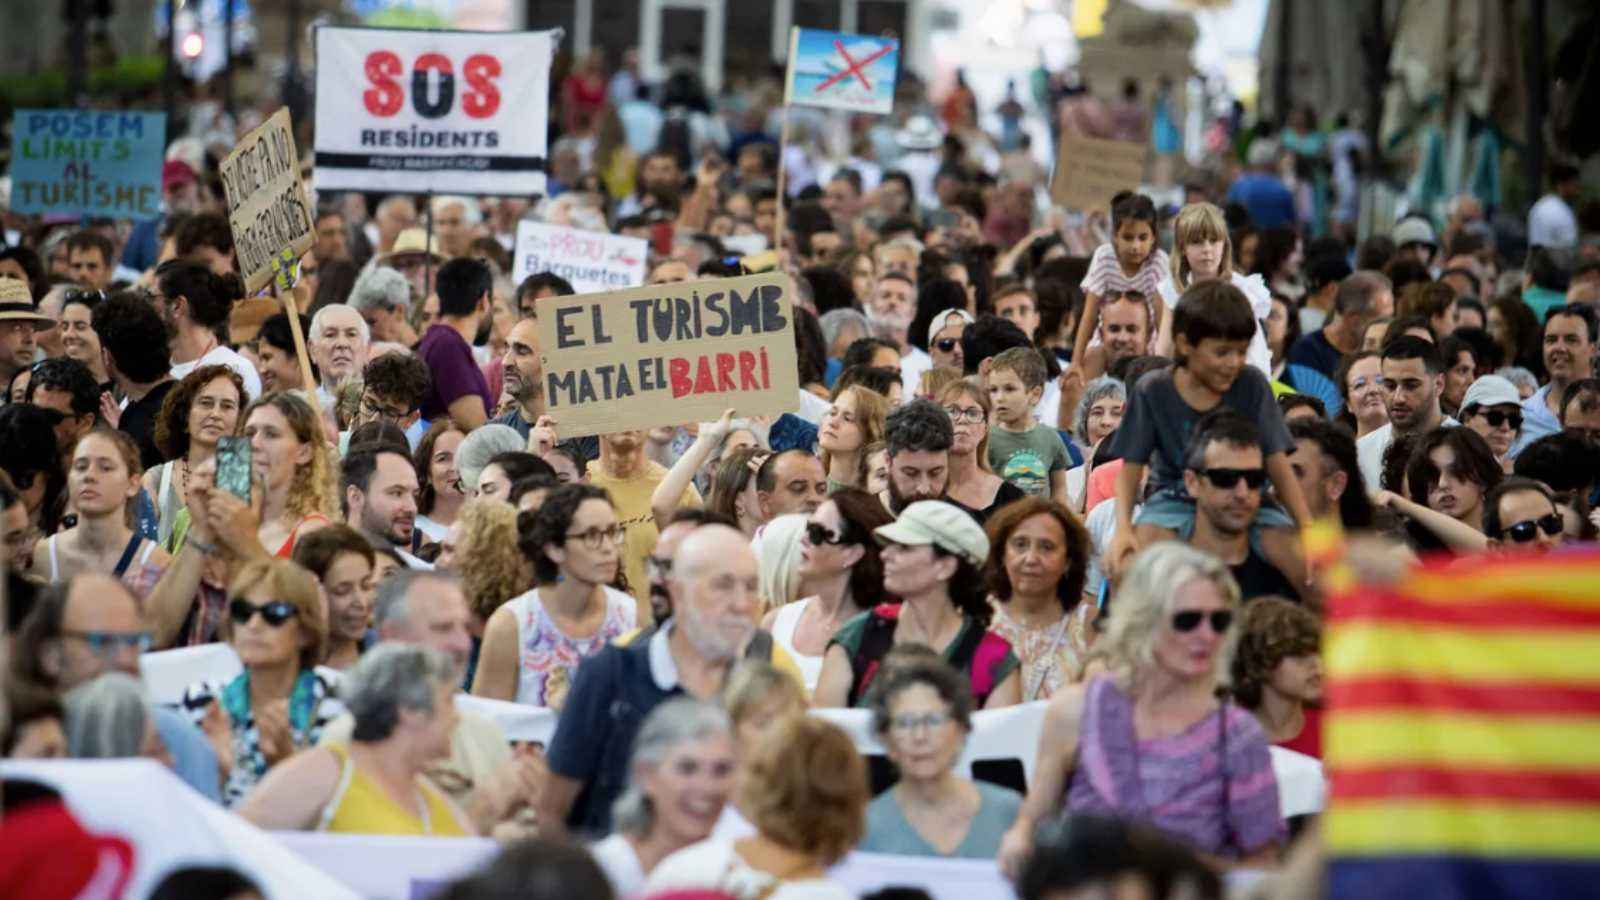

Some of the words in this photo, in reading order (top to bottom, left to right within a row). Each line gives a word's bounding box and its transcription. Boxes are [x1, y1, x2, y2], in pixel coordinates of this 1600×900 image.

[363, 50, 502, 119] SOS
[29, 112, 144, 138] POSEM
[63, 160, 97, 182] AL
[18, 178, 156, 213] TURISME
[526, 254, 631, 286] Barquetes
[556, 304, 612, 349] EL
[630, 285, 787, 343] TURISME
[547, 363, 634, 406] MATA
[638, 357, 667, 391] EL
